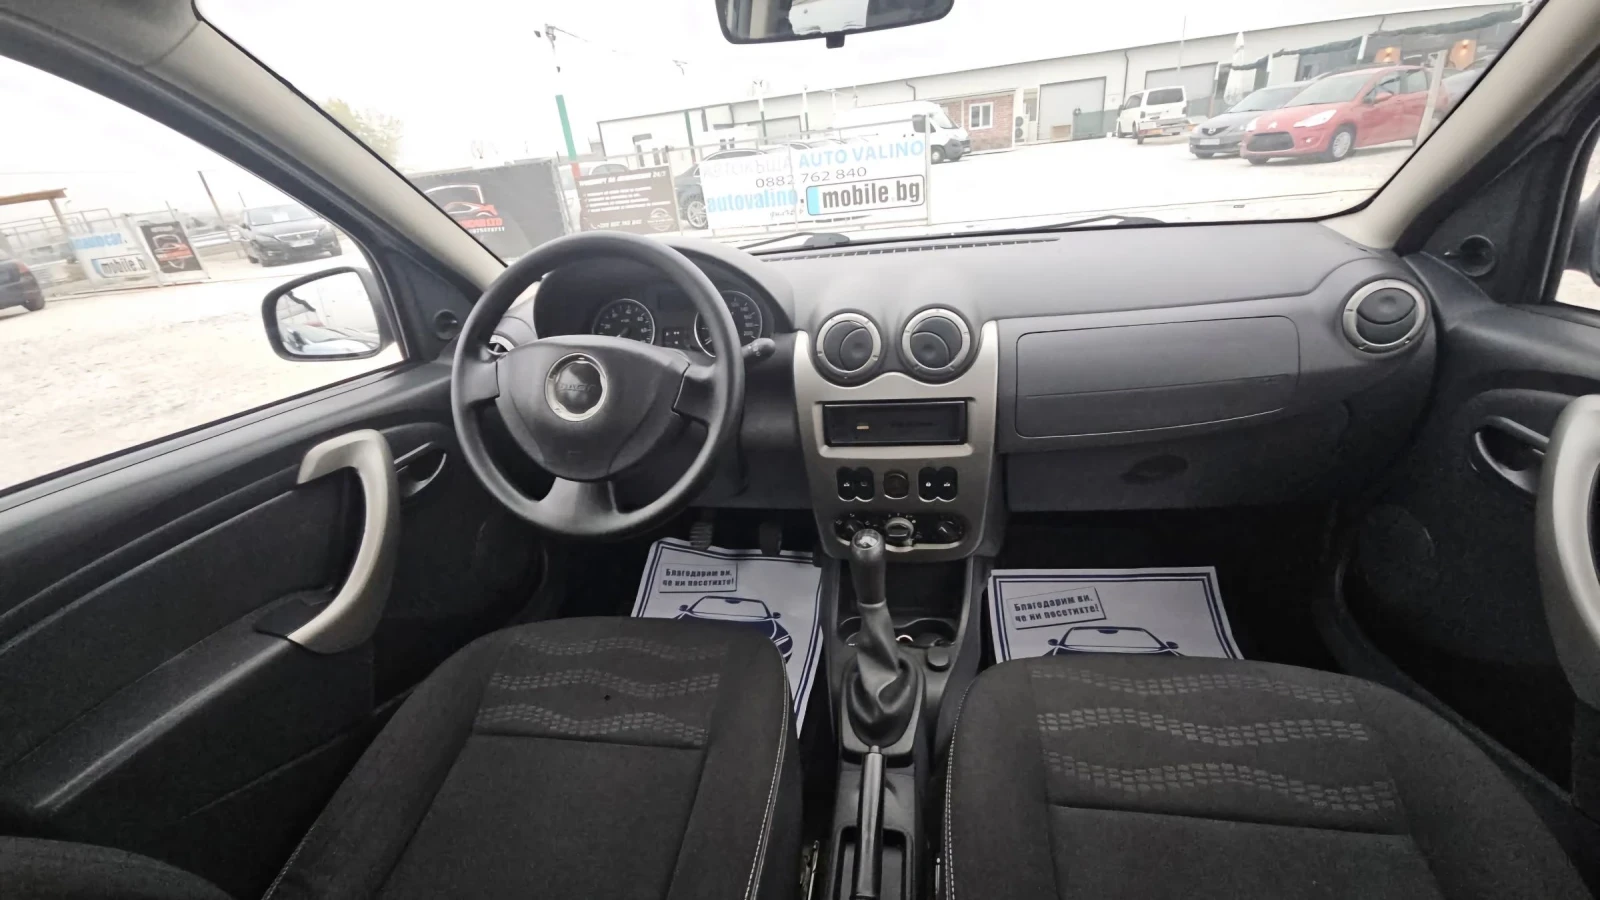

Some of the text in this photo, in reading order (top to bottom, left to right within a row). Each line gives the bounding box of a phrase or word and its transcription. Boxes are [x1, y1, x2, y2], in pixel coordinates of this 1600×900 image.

[799, 140, 924, 168] AUTO VALINO
[756, 167, 867, 188] 0882 762 840
[665, 568, 718, 578] Благодарим
[1014, 596, 1076, 611] Благодарим
[1044, 603, 1100, 619] посетихте!
